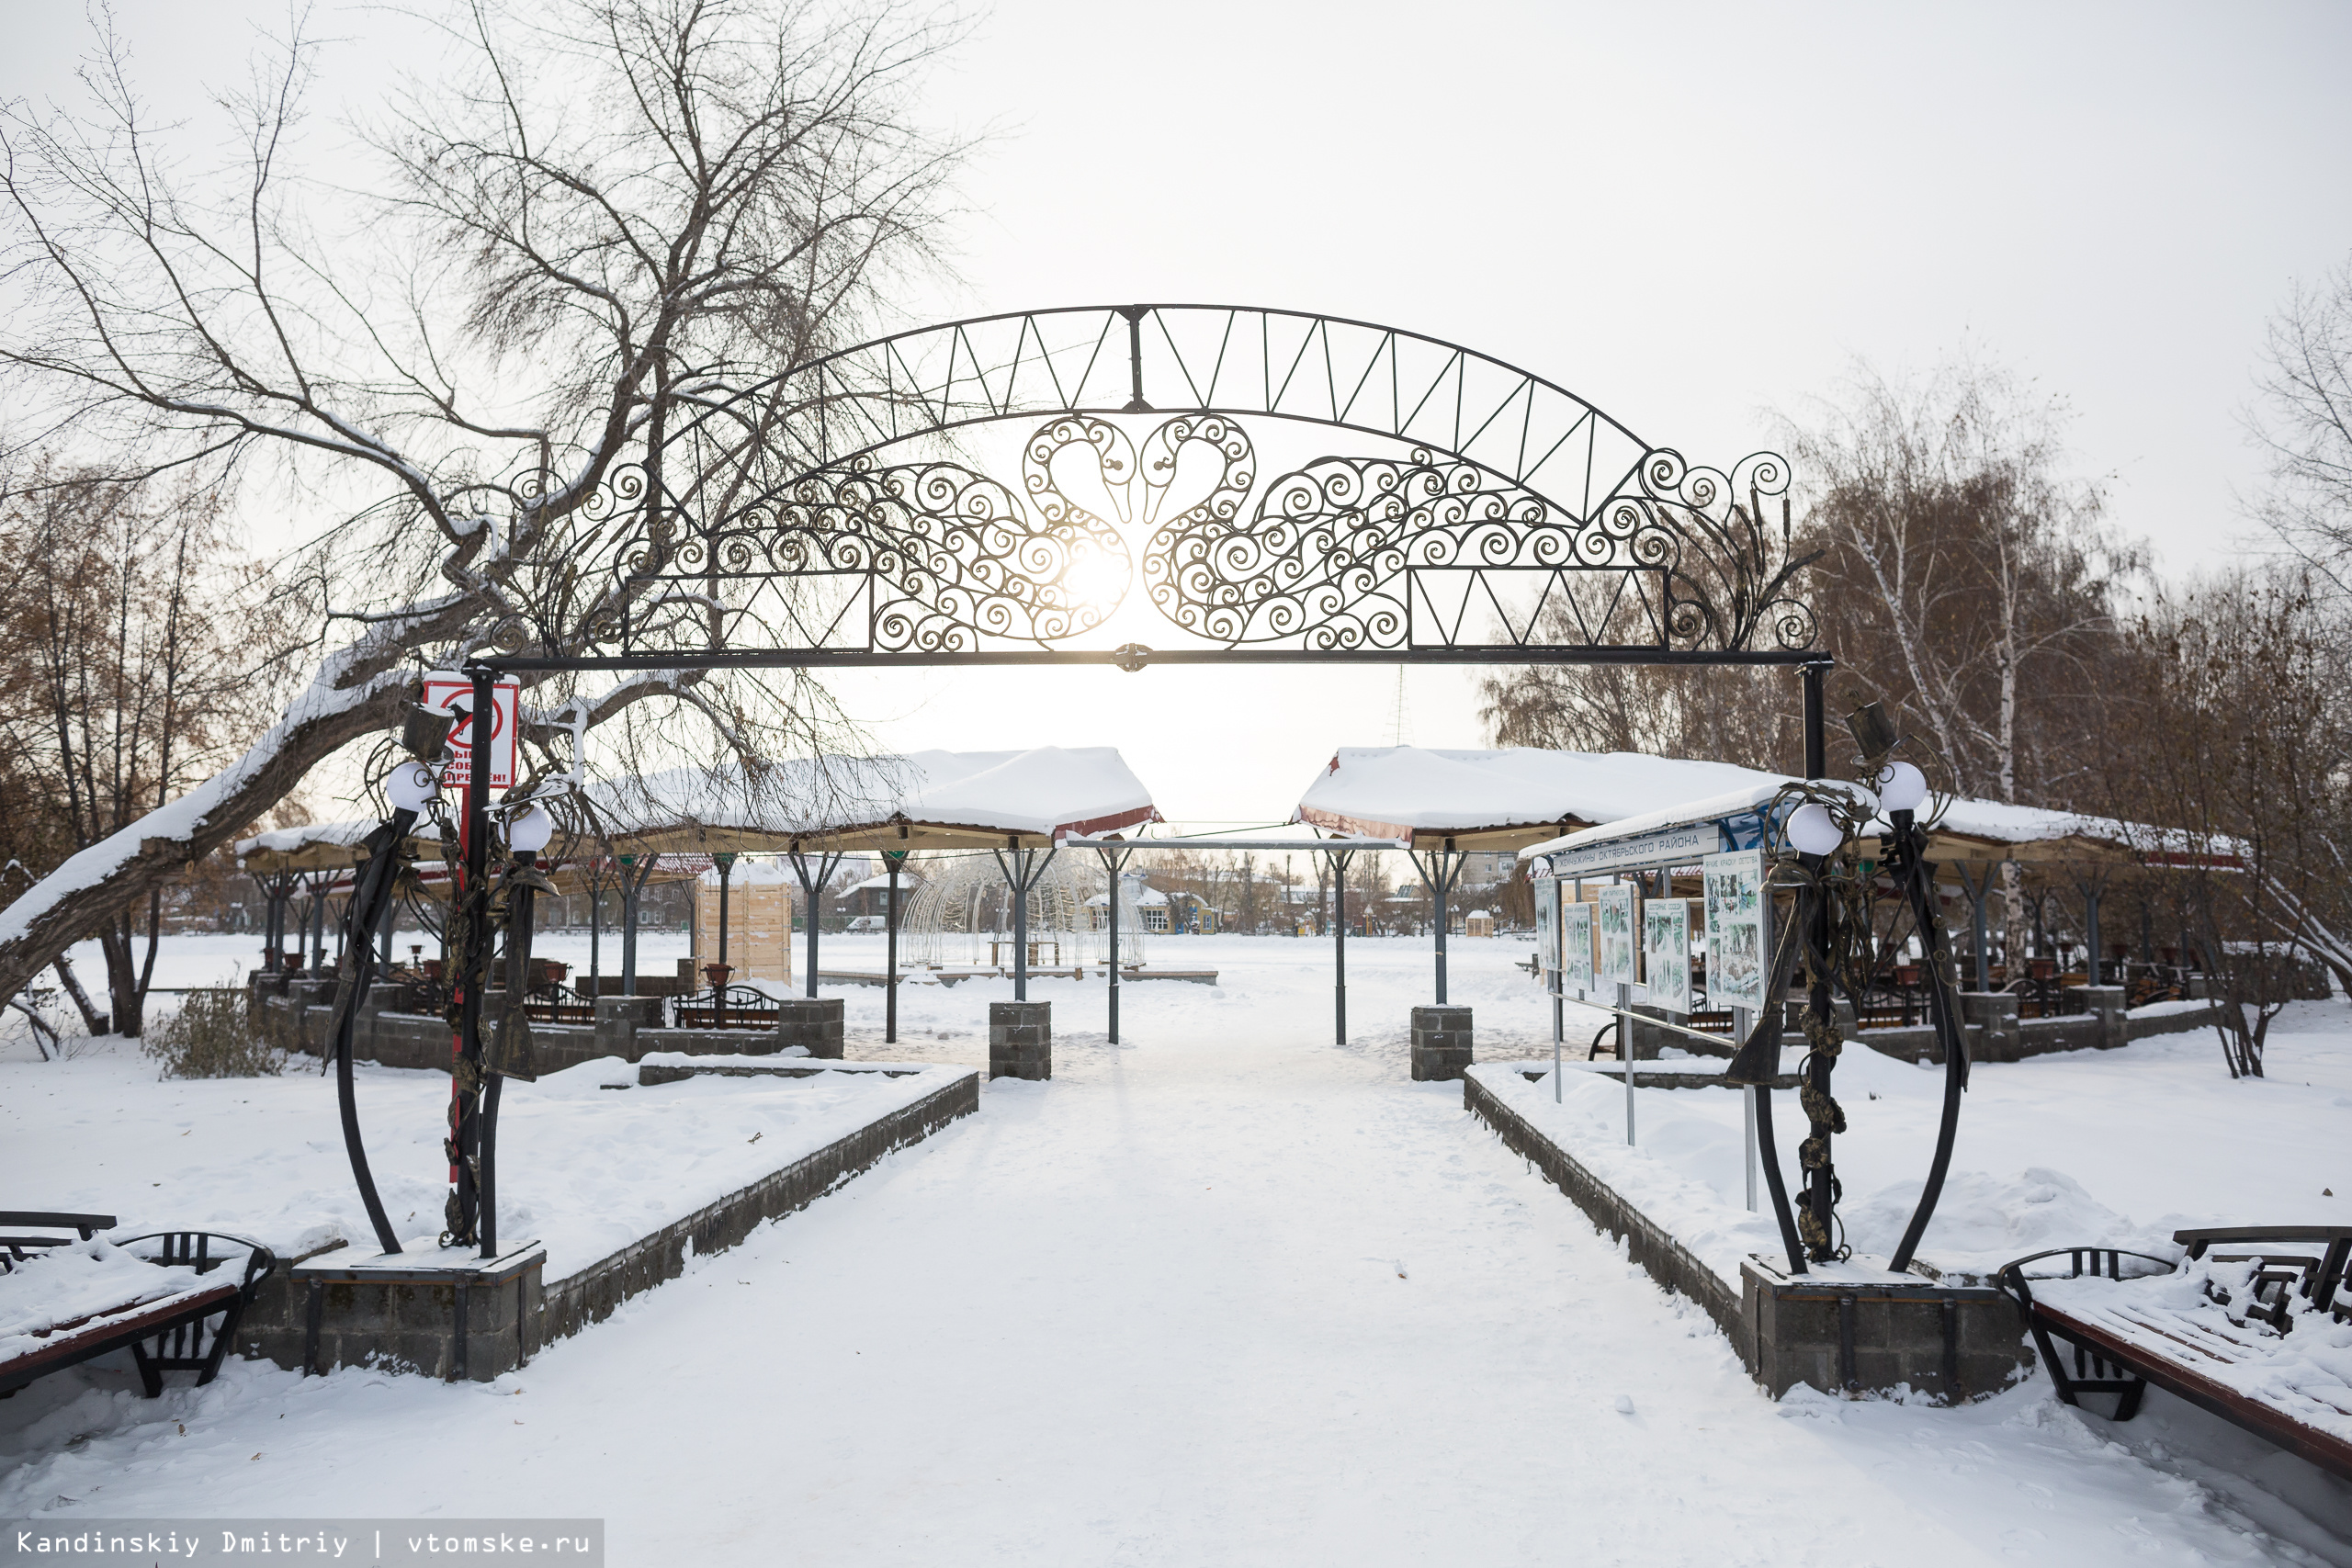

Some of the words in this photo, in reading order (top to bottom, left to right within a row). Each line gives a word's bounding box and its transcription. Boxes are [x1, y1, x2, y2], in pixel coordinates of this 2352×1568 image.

[447, 761, 471, 770] СОБ
[1559, 852, 1596, 867] ЖЕМЧУЖИНЫ
[1599, 842, 1654, 861] ОКТЯБРЬСКОГО
[1659, 835, 1700, 852] РАЙОНА
